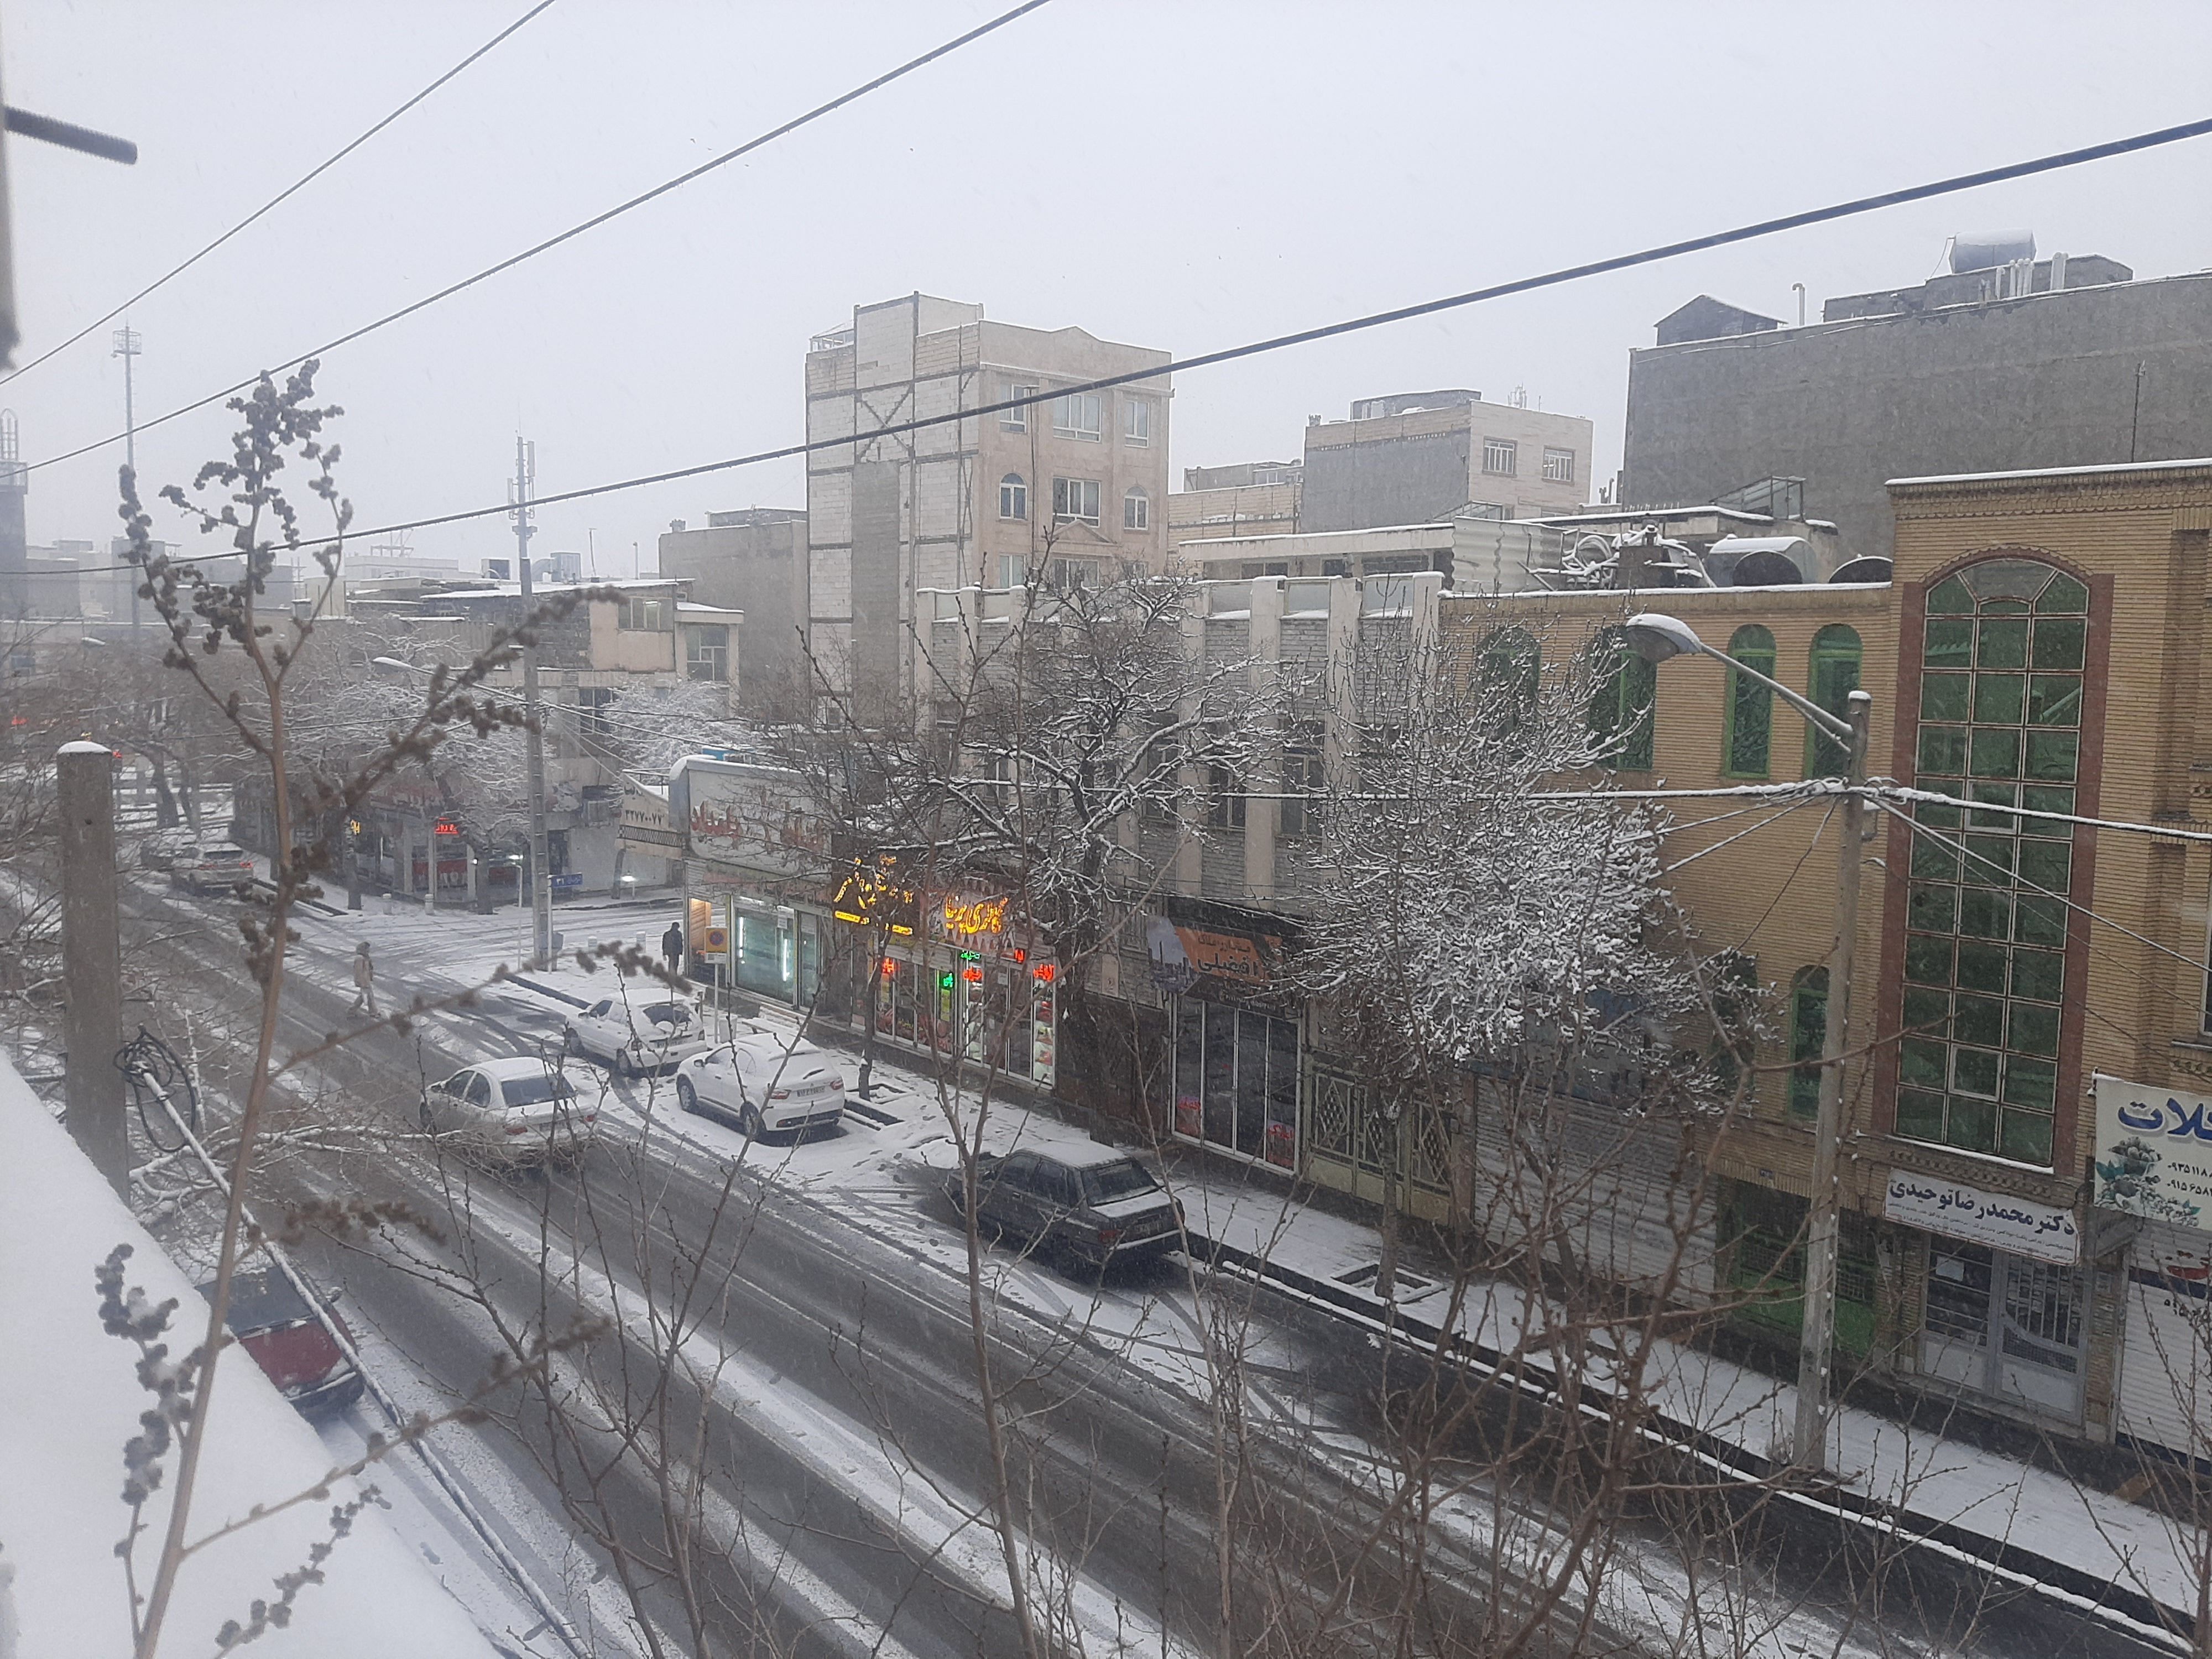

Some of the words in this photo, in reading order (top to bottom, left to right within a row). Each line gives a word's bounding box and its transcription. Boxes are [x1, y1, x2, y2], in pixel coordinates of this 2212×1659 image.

[1197, 952, 1258, 976] افضلی
[2118, 1097, 2212, 1141] لات
[2167, 1162, 2212, 1178] ۰۹۳۵۱۱۸
[1889, 1182, 1953, 1209] توحیدی
[2034, 1214, 2075, 1235] دکتر
